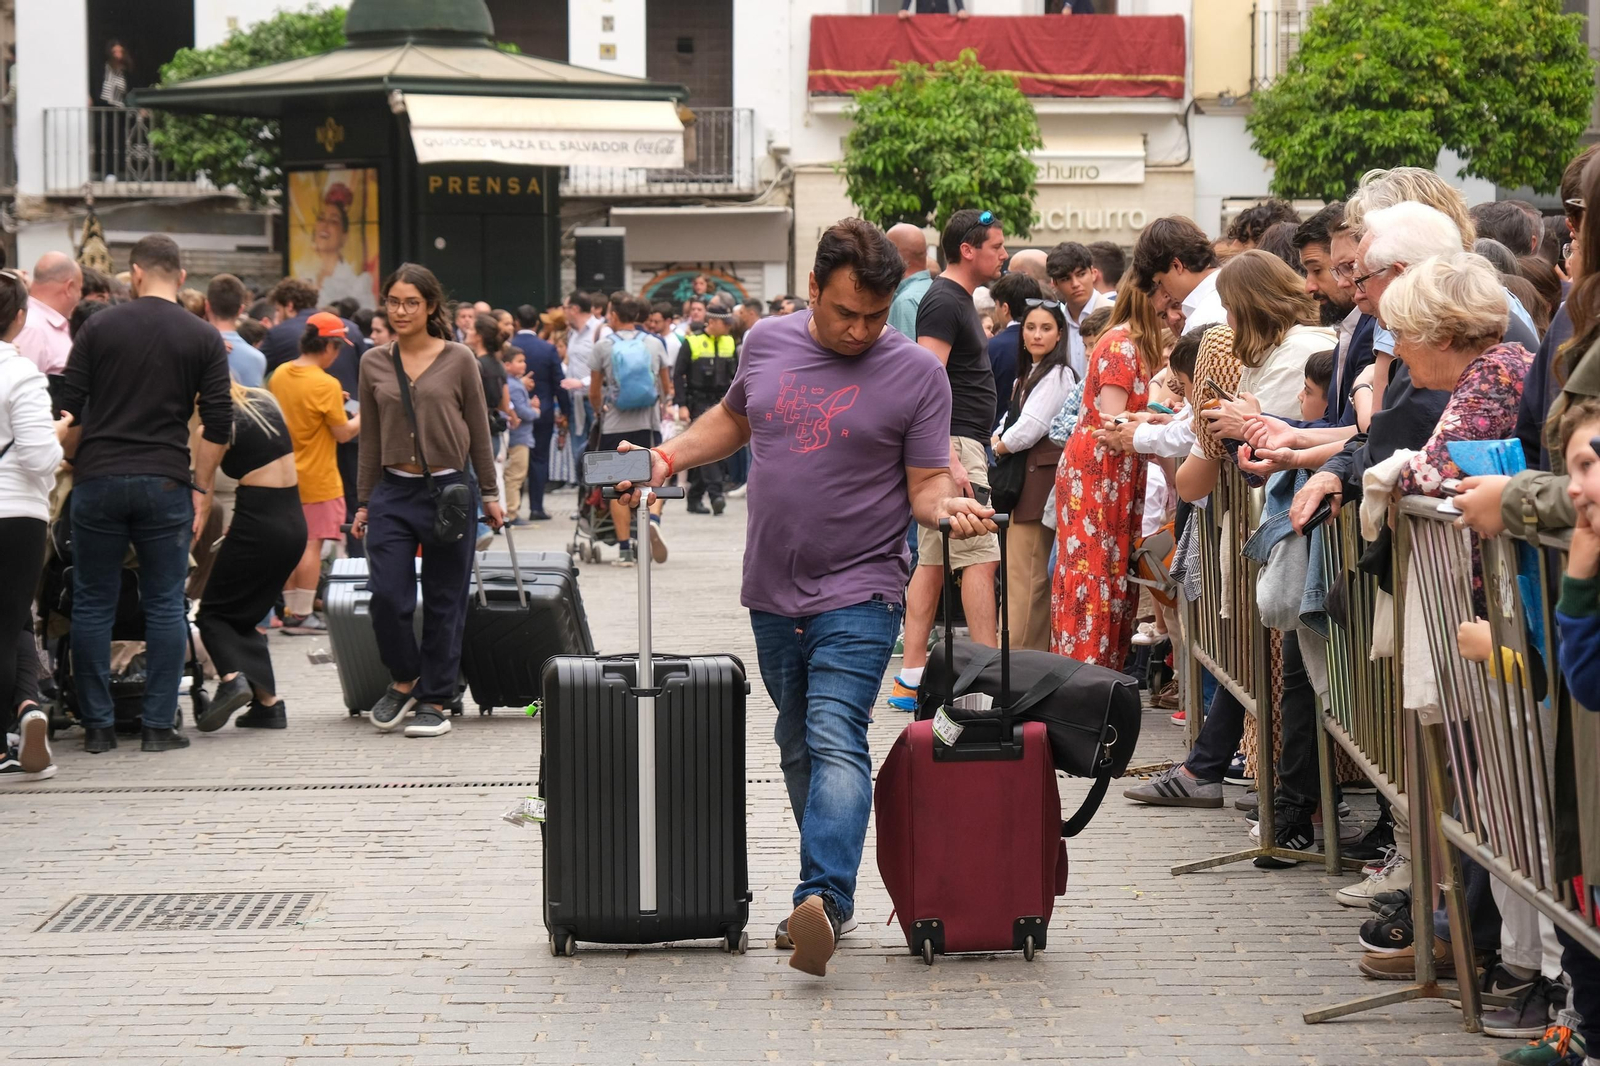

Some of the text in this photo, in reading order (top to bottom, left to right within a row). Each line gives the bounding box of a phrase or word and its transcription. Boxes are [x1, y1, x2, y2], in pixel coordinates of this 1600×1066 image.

[423, 137, 629, 153] QUIOSCO PLAZA EL SALVADOR
[429, 176, 541, 195] PRENSA
[1389, 928, 1403, 941] S
